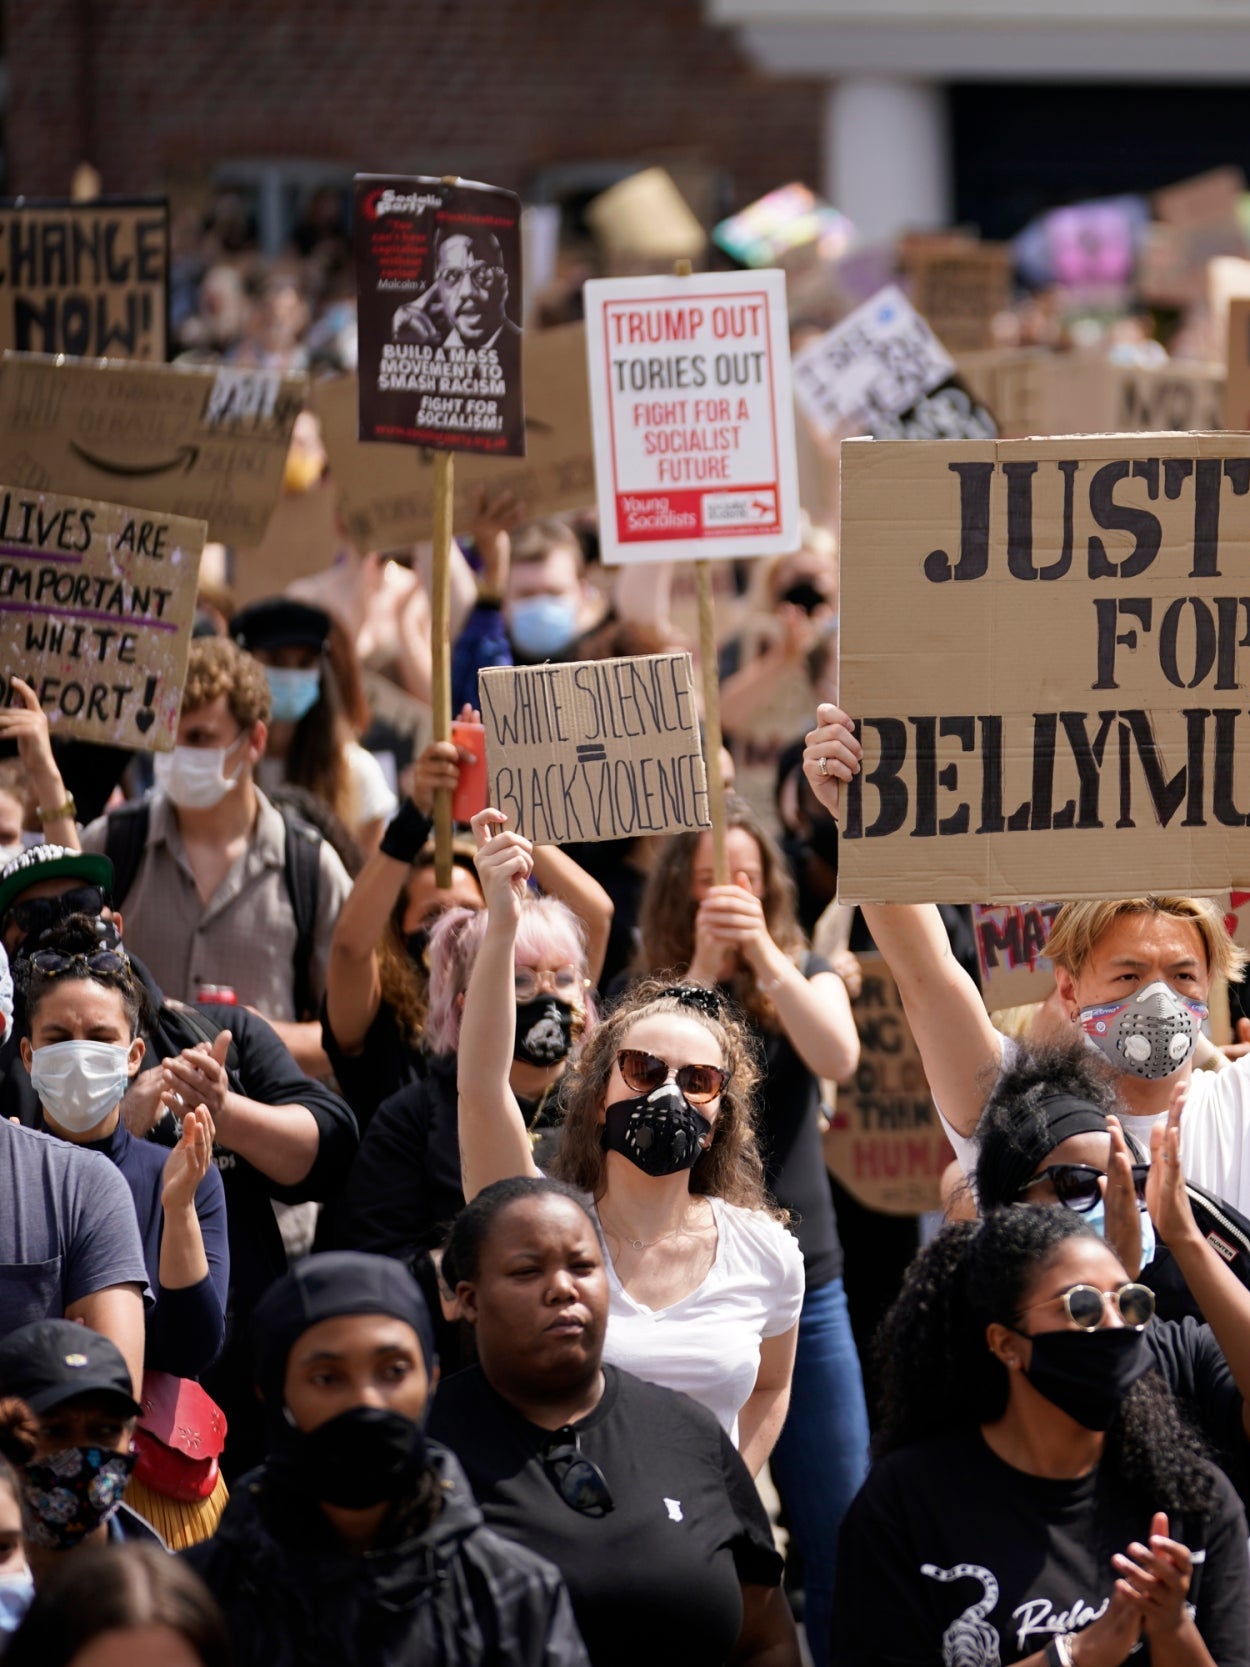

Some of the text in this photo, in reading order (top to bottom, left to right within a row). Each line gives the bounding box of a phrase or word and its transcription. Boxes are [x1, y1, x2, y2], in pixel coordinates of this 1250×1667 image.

[376, 200, 426, 216] Party
[0, 219, 161, 287] HANGE
[377, 278, 427, 290] Malcolm X
[15, 290, 153, 356] NOW!
[612, 305, 763, 344] TRUMP OUT
[383, 344, 499, 364] BUILD A MASS
[378, 374, 506, 395] SMASH RACISM
[380, 359, 503, 380] MOVEMENT TO
[614, 352, 765, 391] TORIES OUT
[420, 396, 498, 414] FIGHT FOR
[633, 397, 750, 427] FIGHT FOR A
[416, 410, 503, 431] SOCIALISM!
[644, 426, 741, 456] SOCIALIST
[658, 455, 732, 482] FUTURE
[622, 496, 670, 514] Young
[0, 493, 96, 551] LIVES
[627, 511, 697, 532] Socialists
[116, 520, 169, 560] ARE
[25, 621, 139, 665] WHITE
[482, 657, 693, 745] WHITE SILENCE
[496, 754, 711, 842] BLACK VIOLENCE
[854, 1136, 958, 1179] HUMA
[1208, 1235, 1234, 1257] HUNTER
